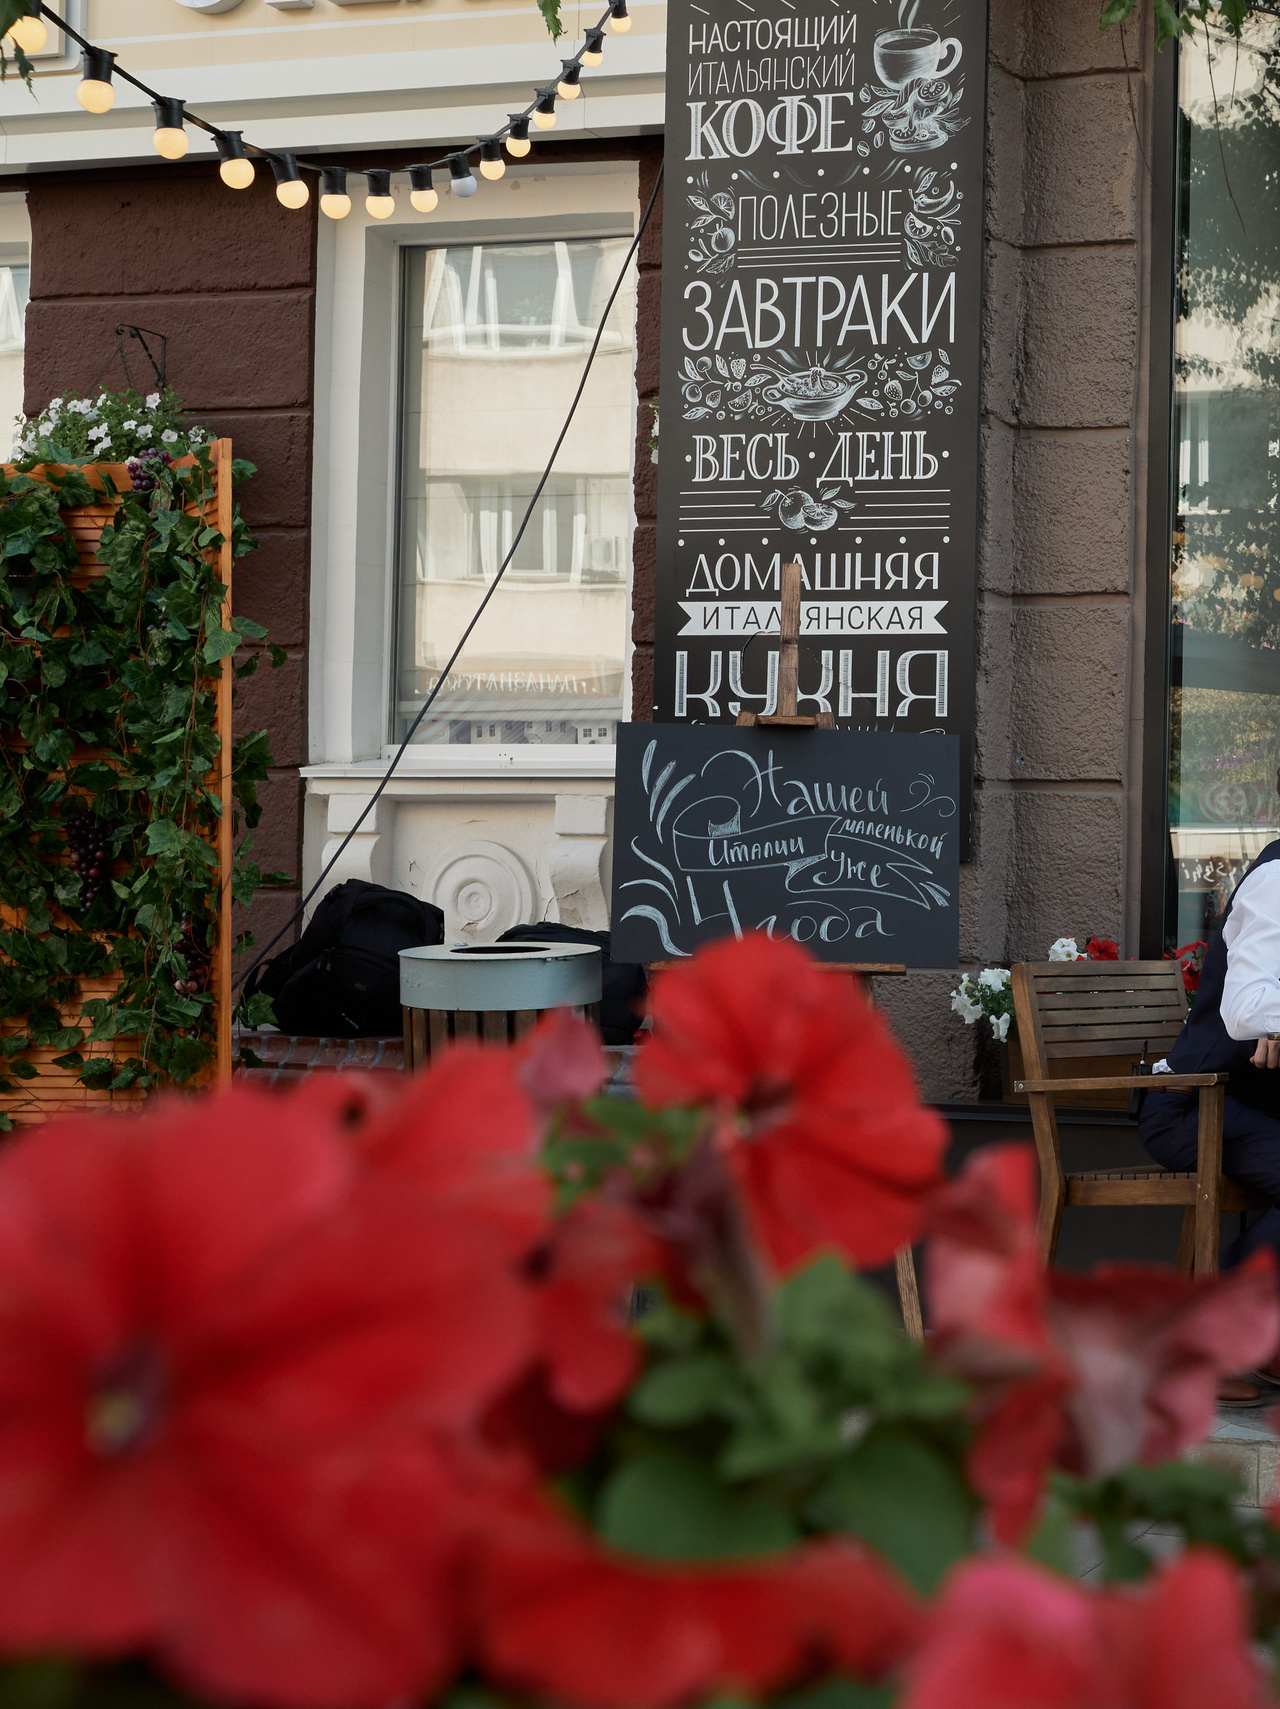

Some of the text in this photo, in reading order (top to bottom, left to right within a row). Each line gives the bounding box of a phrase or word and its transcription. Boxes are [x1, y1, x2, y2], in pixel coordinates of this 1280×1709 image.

[689, 10, 857, 54] НАСТОЯЩИЙ
[689, 48, 855, 96] ИТАЛЬЯНСКИЙ
[685, 92, 854, 160] КОФЕ
[738, 190, 902, 241] ПОЛЕЗНЫЕ
[682, 272, 956, 351] ЗАВТРАКИ
[692, 430, 939, 488] ВЕСЬ ДЕНЬ
[703, 605, 924, 631] ИТАЛЯНСКАЯ
[701, 750, 889, 817] Нашей
[756, 901, 895, 942] года
